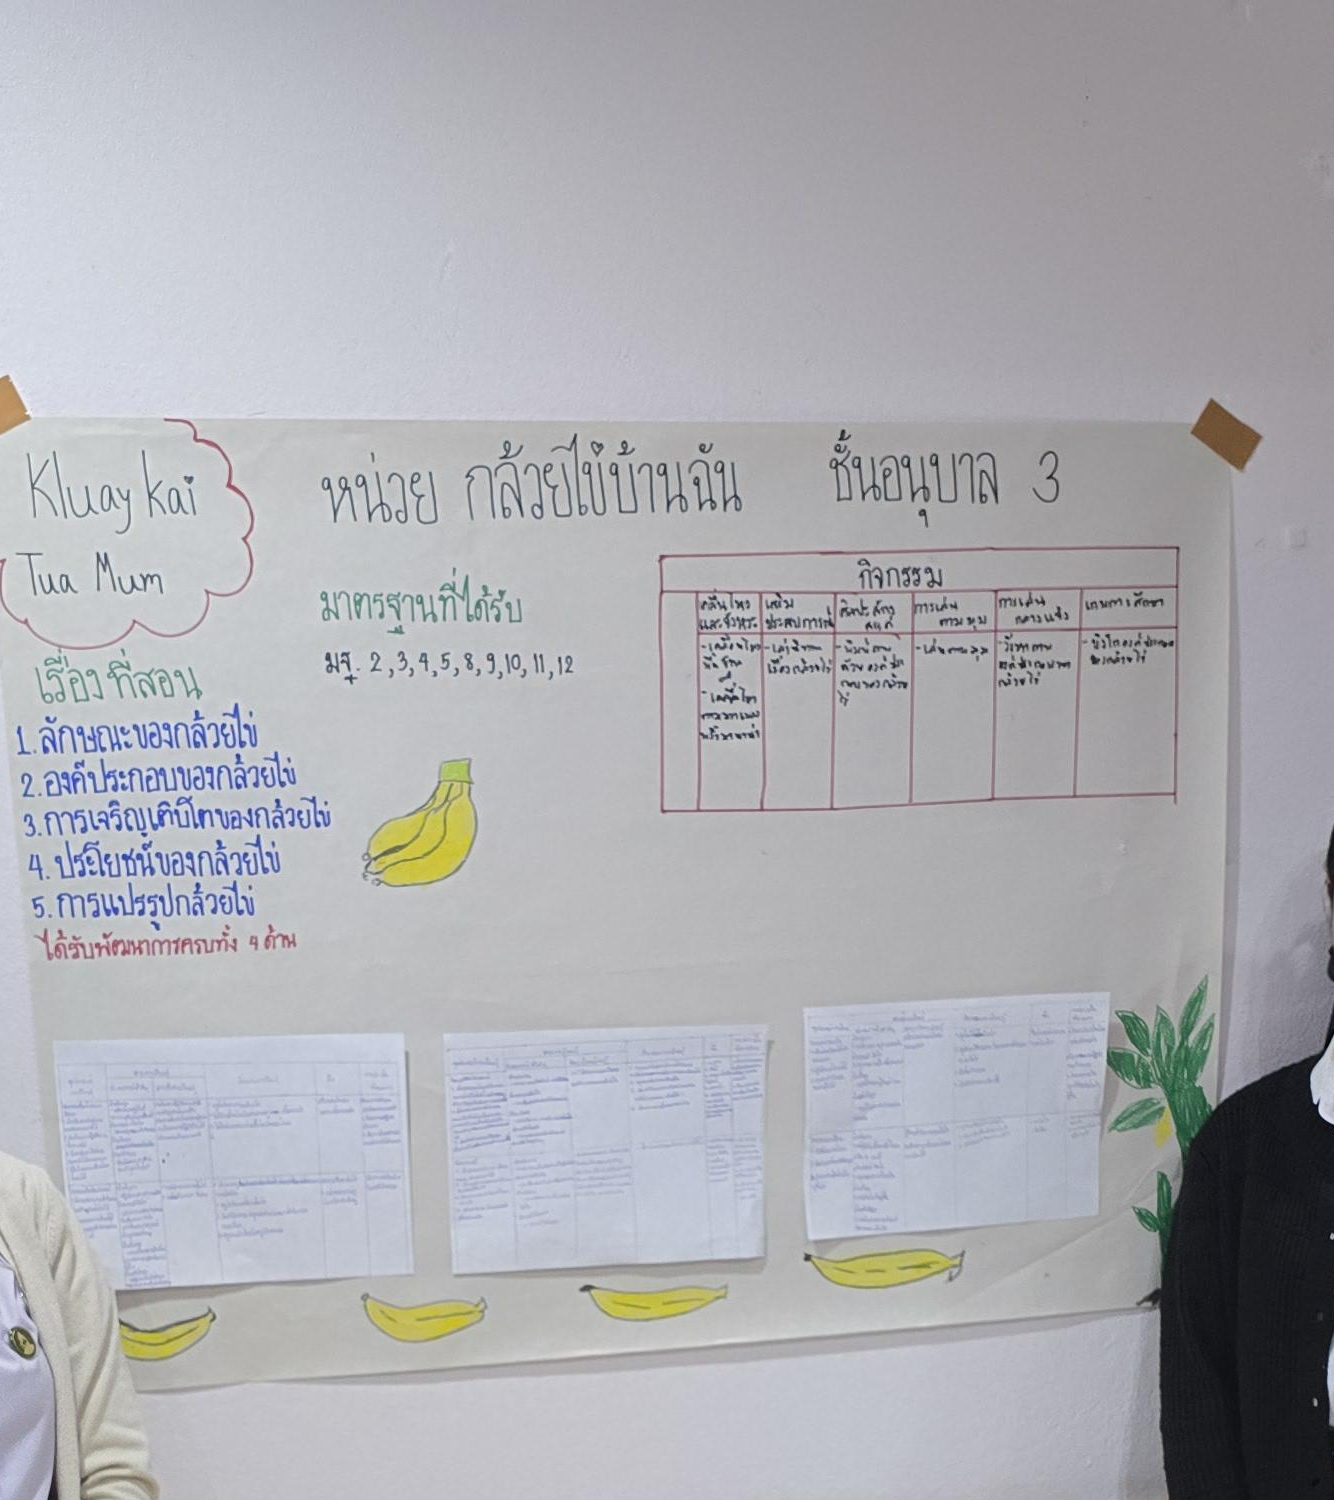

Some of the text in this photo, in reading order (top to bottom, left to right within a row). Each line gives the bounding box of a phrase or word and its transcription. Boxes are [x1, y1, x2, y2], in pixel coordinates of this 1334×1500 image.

[26, 450, 132, 534] Kluay
[321, 429, 1060, 528] หน่วย กล้วยไข่บ้านฉัน ชั้นอนุบาล 3
[15, 551, 164, 596] Tua Mum
[857, 558, 943, 589] กิจกรรม
[264, 924, 297, 951] ด้าน
